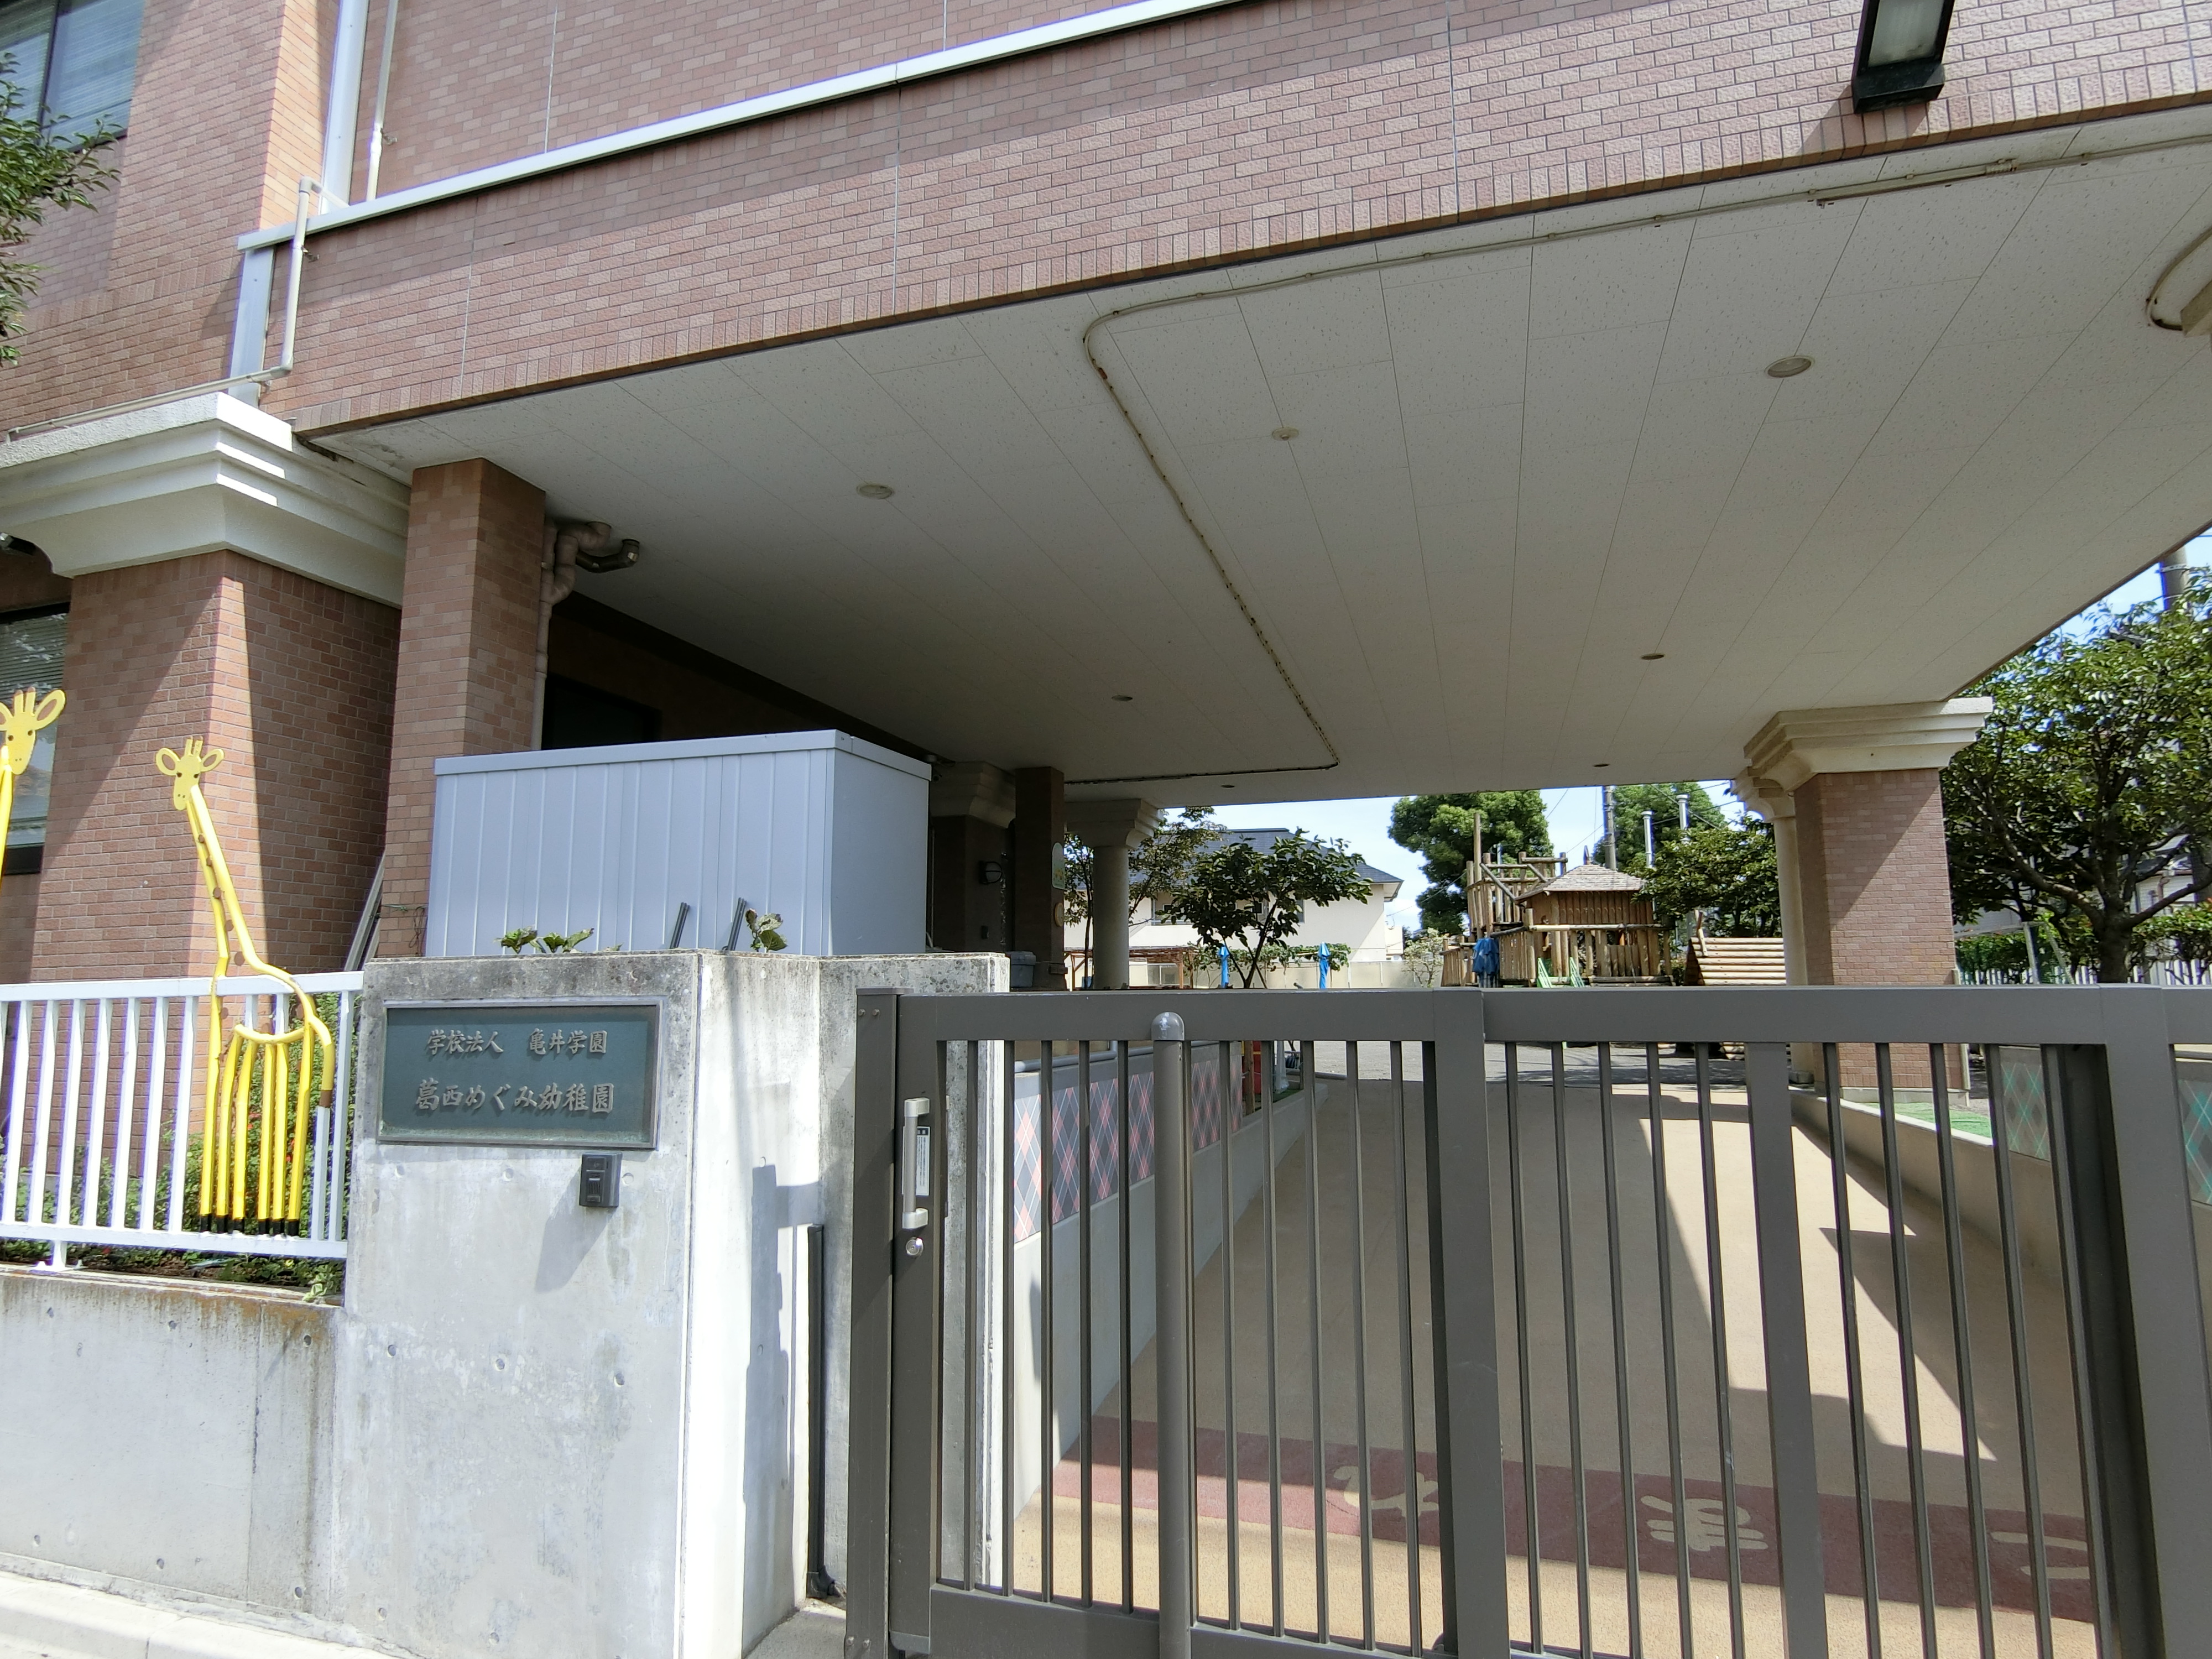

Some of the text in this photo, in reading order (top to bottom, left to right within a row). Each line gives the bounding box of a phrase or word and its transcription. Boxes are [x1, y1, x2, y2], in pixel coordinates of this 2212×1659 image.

[427, 1028, 607, 1055] 学校法人 亀井学園
[416, 1077, 614, 1114] 葛西めぐみ幼稚園
